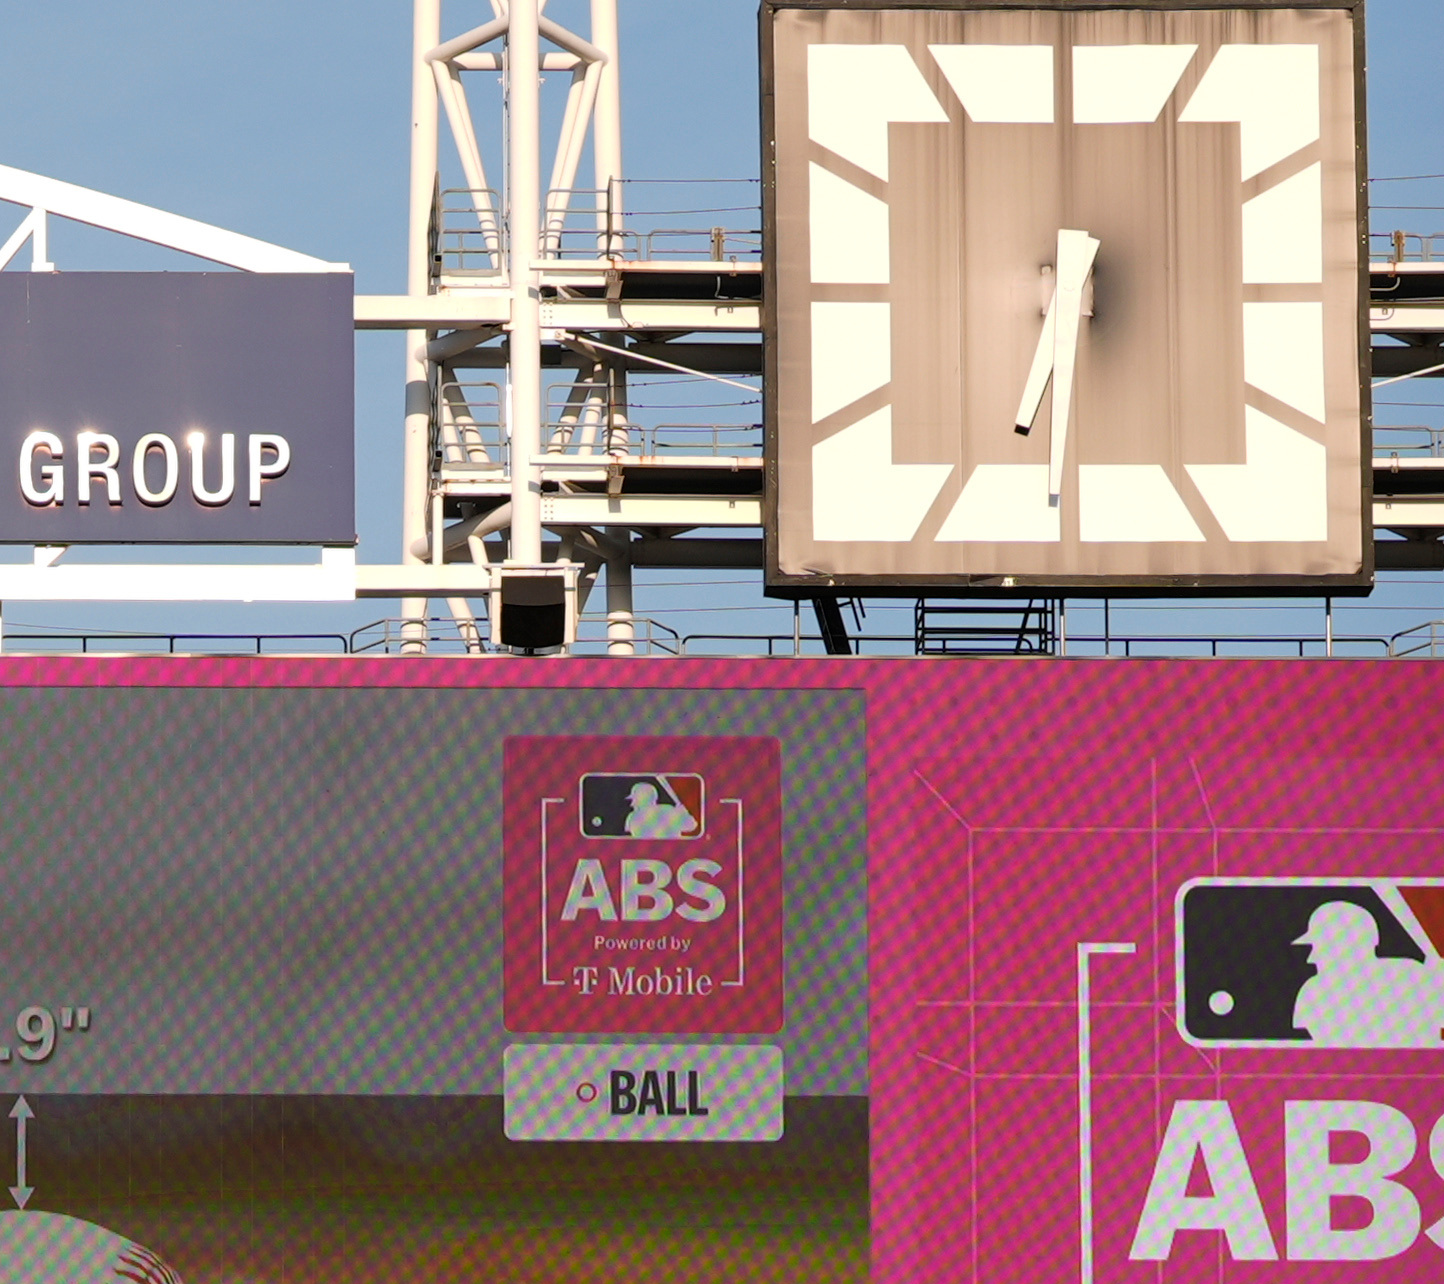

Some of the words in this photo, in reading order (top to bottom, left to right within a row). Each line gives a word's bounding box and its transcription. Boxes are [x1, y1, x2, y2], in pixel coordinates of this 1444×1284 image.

[18, 431, 292, 506] GROUP
[561, 857, 726, 923] ABS
[594, 935, 667, 951] Powered
[672, 935, 691, 955] by
[607, 966, 712, 997] Mobile
[610, 1070, 708, 1116] BALL
